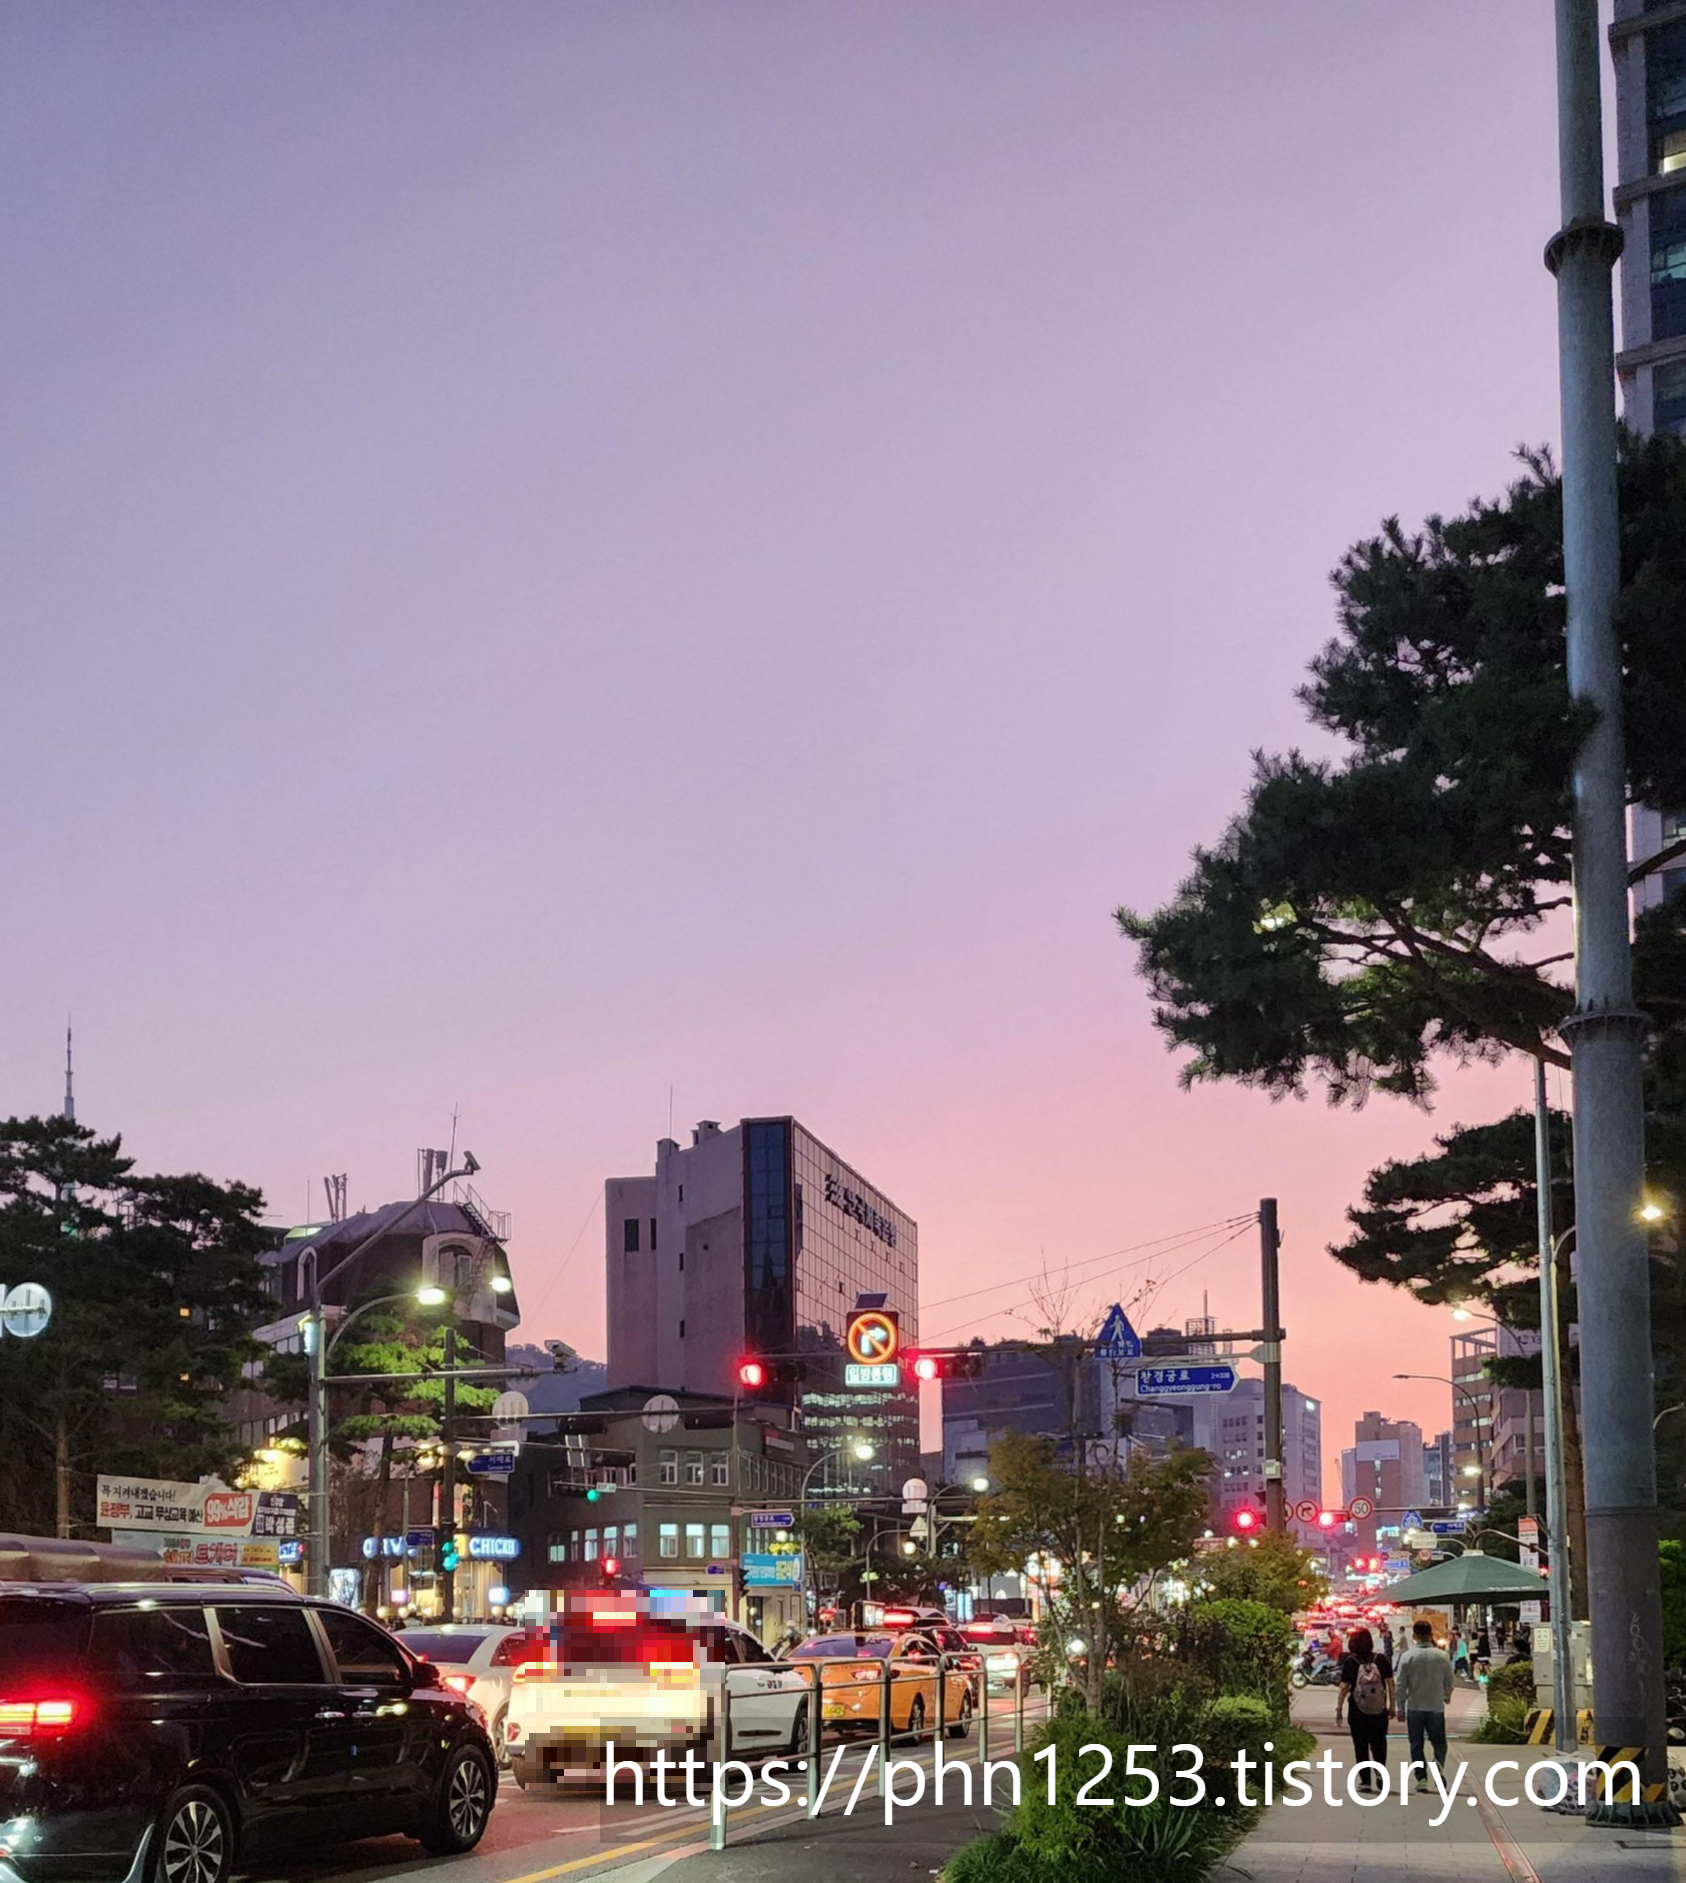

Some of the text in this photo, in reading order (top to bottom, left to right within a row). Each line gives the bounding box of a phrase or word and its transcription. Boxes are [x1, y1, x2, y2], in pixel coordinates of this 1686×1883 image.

[1140, 1370, 1191, 1383] 창경궁로
[1140, 1383, 1222, 1393] Changgyeonggung-ro
[101, 1484, 177, 1503] 꼭 지켜내겠습니다!
[100, 1501, 133, 1519] 윤정부,
[134, 1504, 154, 1520] 고교
[155, 1506, 188, 1522] 무상교육
[1354, 1502, 1369, 1514] 50
